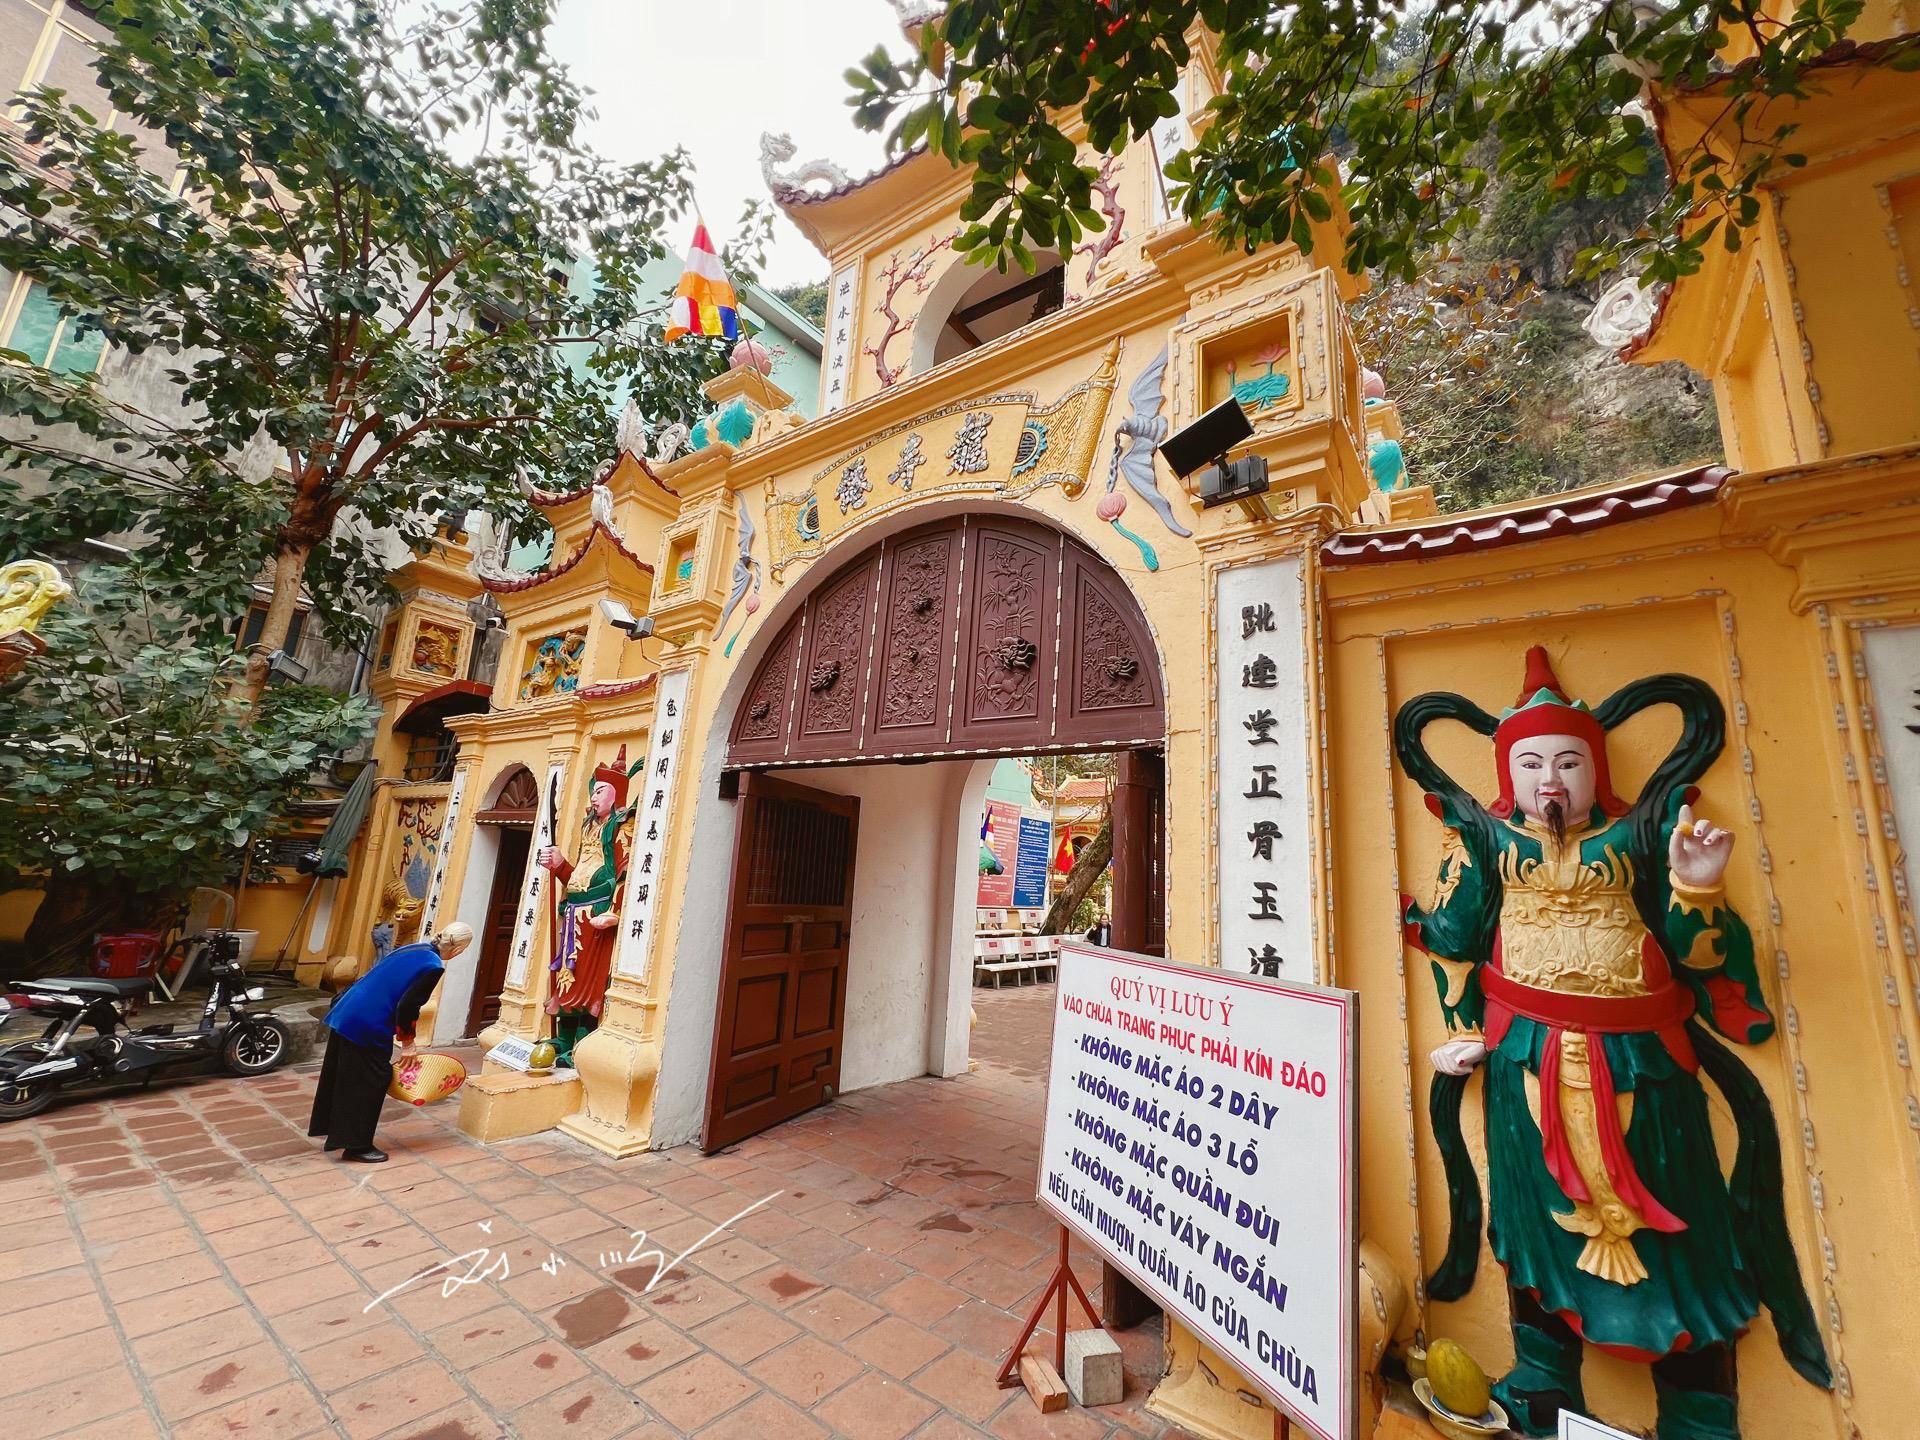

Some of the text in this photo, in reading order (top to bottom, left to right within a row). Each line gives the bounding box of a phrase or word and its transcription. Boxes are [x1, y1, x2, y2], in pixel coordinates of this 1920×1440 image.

[1063, 993, 1326, 1098] VÀO CHÙA TRANG PHỤC PHẢI KÍN ĐÁO
[1110, 975, 1235, 1027] QUÝ VỊ LƯU Ý
[1077, 1070, 1259, 1176] KHÔNG MẶC ÁO 3 LỖ
[1080, 1033, 1280, 1131] KHÔNG MẶC ÁO 2 DÂY
[1070, 1146, 1288, 1313] KHÔNG MẶC VÁY NGẮN
[1074, 1108, 1281, 1248] KHÔNG MẶC QUẦN ĐÙI
[1048, 1170, 1319, 1406] NẾU CẦN MƯỢN QUẦN ÁO CỦA CHÙA
